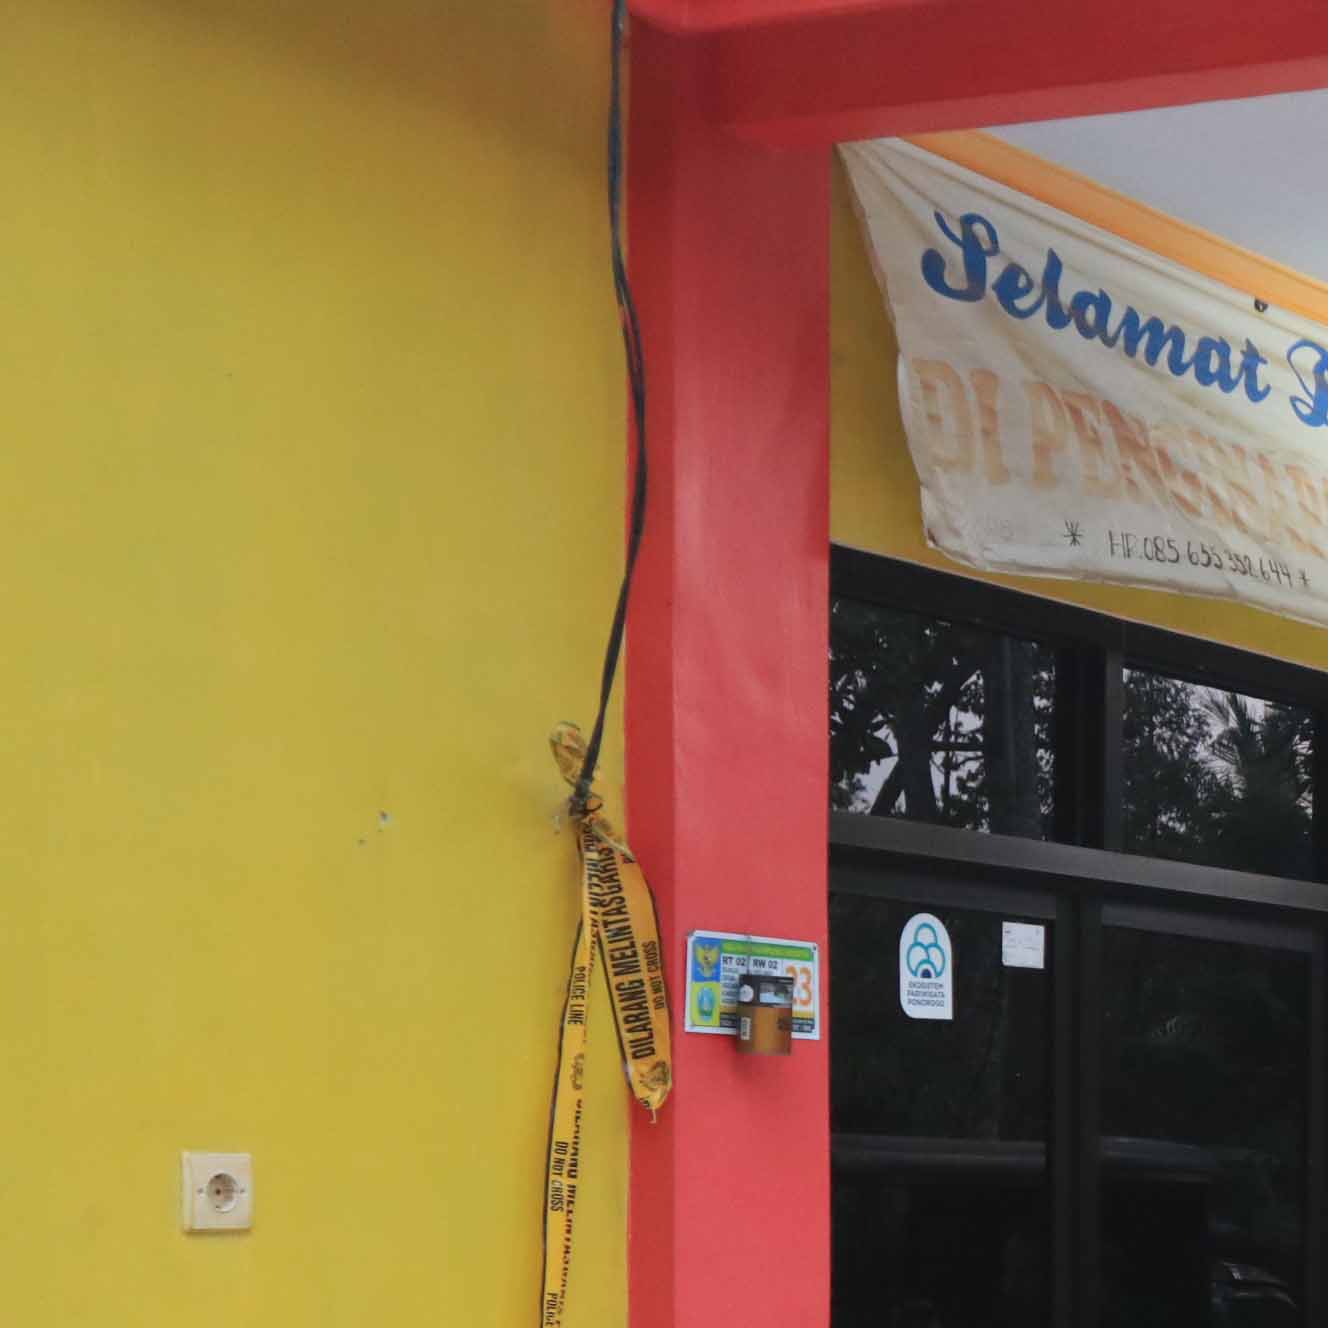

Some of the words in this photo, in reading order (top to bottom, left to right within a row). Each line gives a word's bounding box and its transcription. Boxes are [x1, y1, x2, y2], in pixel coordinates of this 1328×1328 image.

[921, 207, 1271, 403] Selamat
[912, 358, 1010, 486] DI
[570, 966, 586, 1001] POLICE
[568, 1004, 585, 1025] LINE
[554, 1140, 569, 1156] DO
[552, 1158, 567, 1178] NOT
[550, 1181, 564, 1212] CROSS
